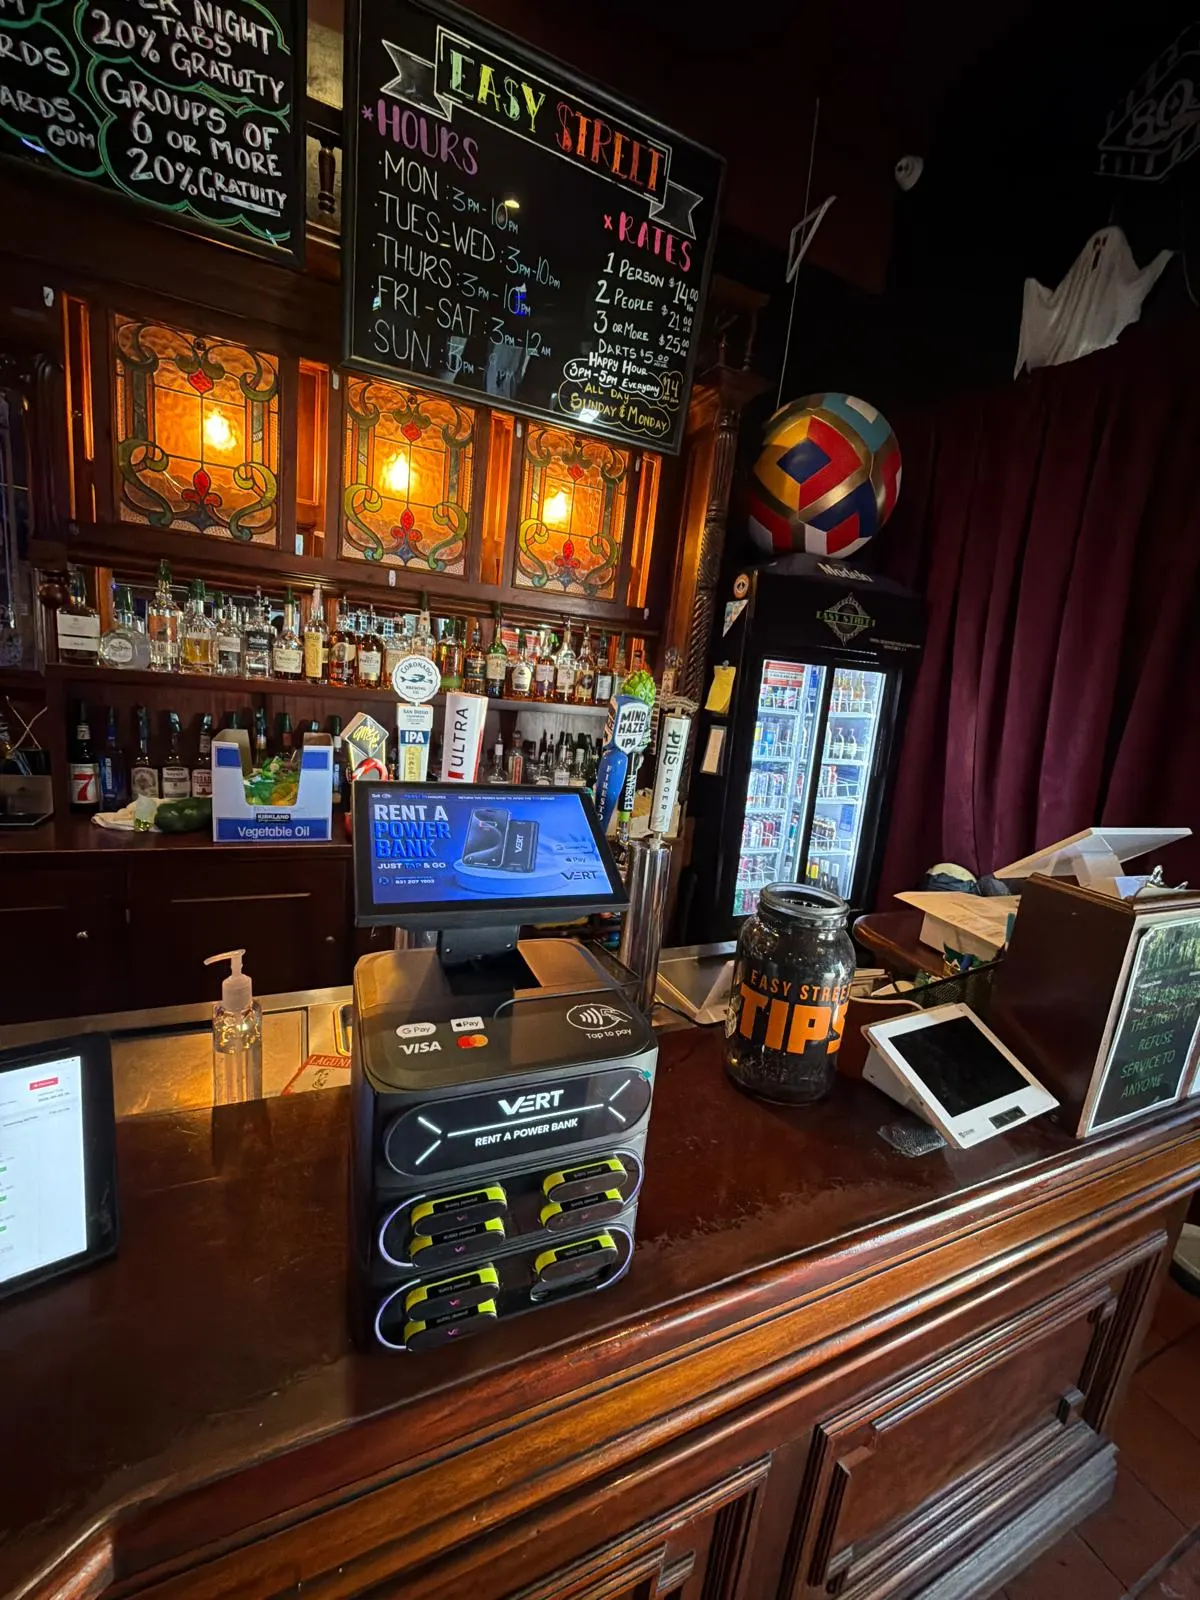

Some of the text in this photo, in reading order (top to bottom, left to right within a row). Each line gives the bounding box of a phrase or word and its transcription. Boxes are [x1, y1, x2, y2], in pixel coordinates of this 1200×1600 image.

[153, 15, 232, 57] TABS
[194, 0, 274, 54] NIGHT
[91, 9, 284, 103] 20% GRATUITY
[100, 69, 279, 150] GROUPS OF
[450, 50, 664, 191] EASY STREET
[132, 112, 282, 177] 6 OR MORE
[377, 99, 478, 175] HOURS
[127, 148, 287, 209] 20% GRATUITY
[619, 211, 691, 272] RATES
[603, 252, 615, 274] 1
[619, 259, 664, 288] PERSON
[595, 280, 610, 304] 2
[613, 288, 653, 312] PEOPLE
[593, 309, 607, 334] 3
[598, 338, 637, 360] DARTS
[589, 352, 648, 376] HAPPY HOUR
[584, 382, 630, 404] ALL DAY
[622, 378, 660, 397] EVERYDAY
[570, 392, 617, 418] SUNDAY
[627, 408, 667, 432] MONDAY
[400, 661, 433, 677] CORONADO
[618, 722, 645, 734] HAZE
[621, 710, 646, 723] MIND
[405, 732, 425, 744] IPA
[451, 707, 469, 767] ULTRA
[621, 737, 636, 748] IPA
[74, 773, 96, 800] 7
[661, 769, 673, 810] LAGER
[373, 804, 448, 821] RENT A
[238, 825, 310, 838] Vegetable Oil
[374, 821, 451, 839] POWER
[375, 839, 437, 858] BANK
[514, 833, 525, 854] VERT
[560, 871, 597, 881] VERT
[751, 969, 850, 1002] EASY STREE
[413, 1025, 431, 1036] Pay
[463, 1019, 480, 1030] Pay
[739, 982, 849, 1055] TIPS
[1131, 1015, 1151, 1033] THE
[586, 1028, 632, 1041] Tap to pay
[1138, 1029, 1175, 1051] REFUSE
[399, 1041, 442, 1055] VISA
[1121, 1049, 1176, 1079] SERVICE TO
[1121, 1073, 1164, 1099] ANYONE
[497, 1089, 564, 1115] VERT
[475, 1117, 578, 1147] RENT A POWER BANK
